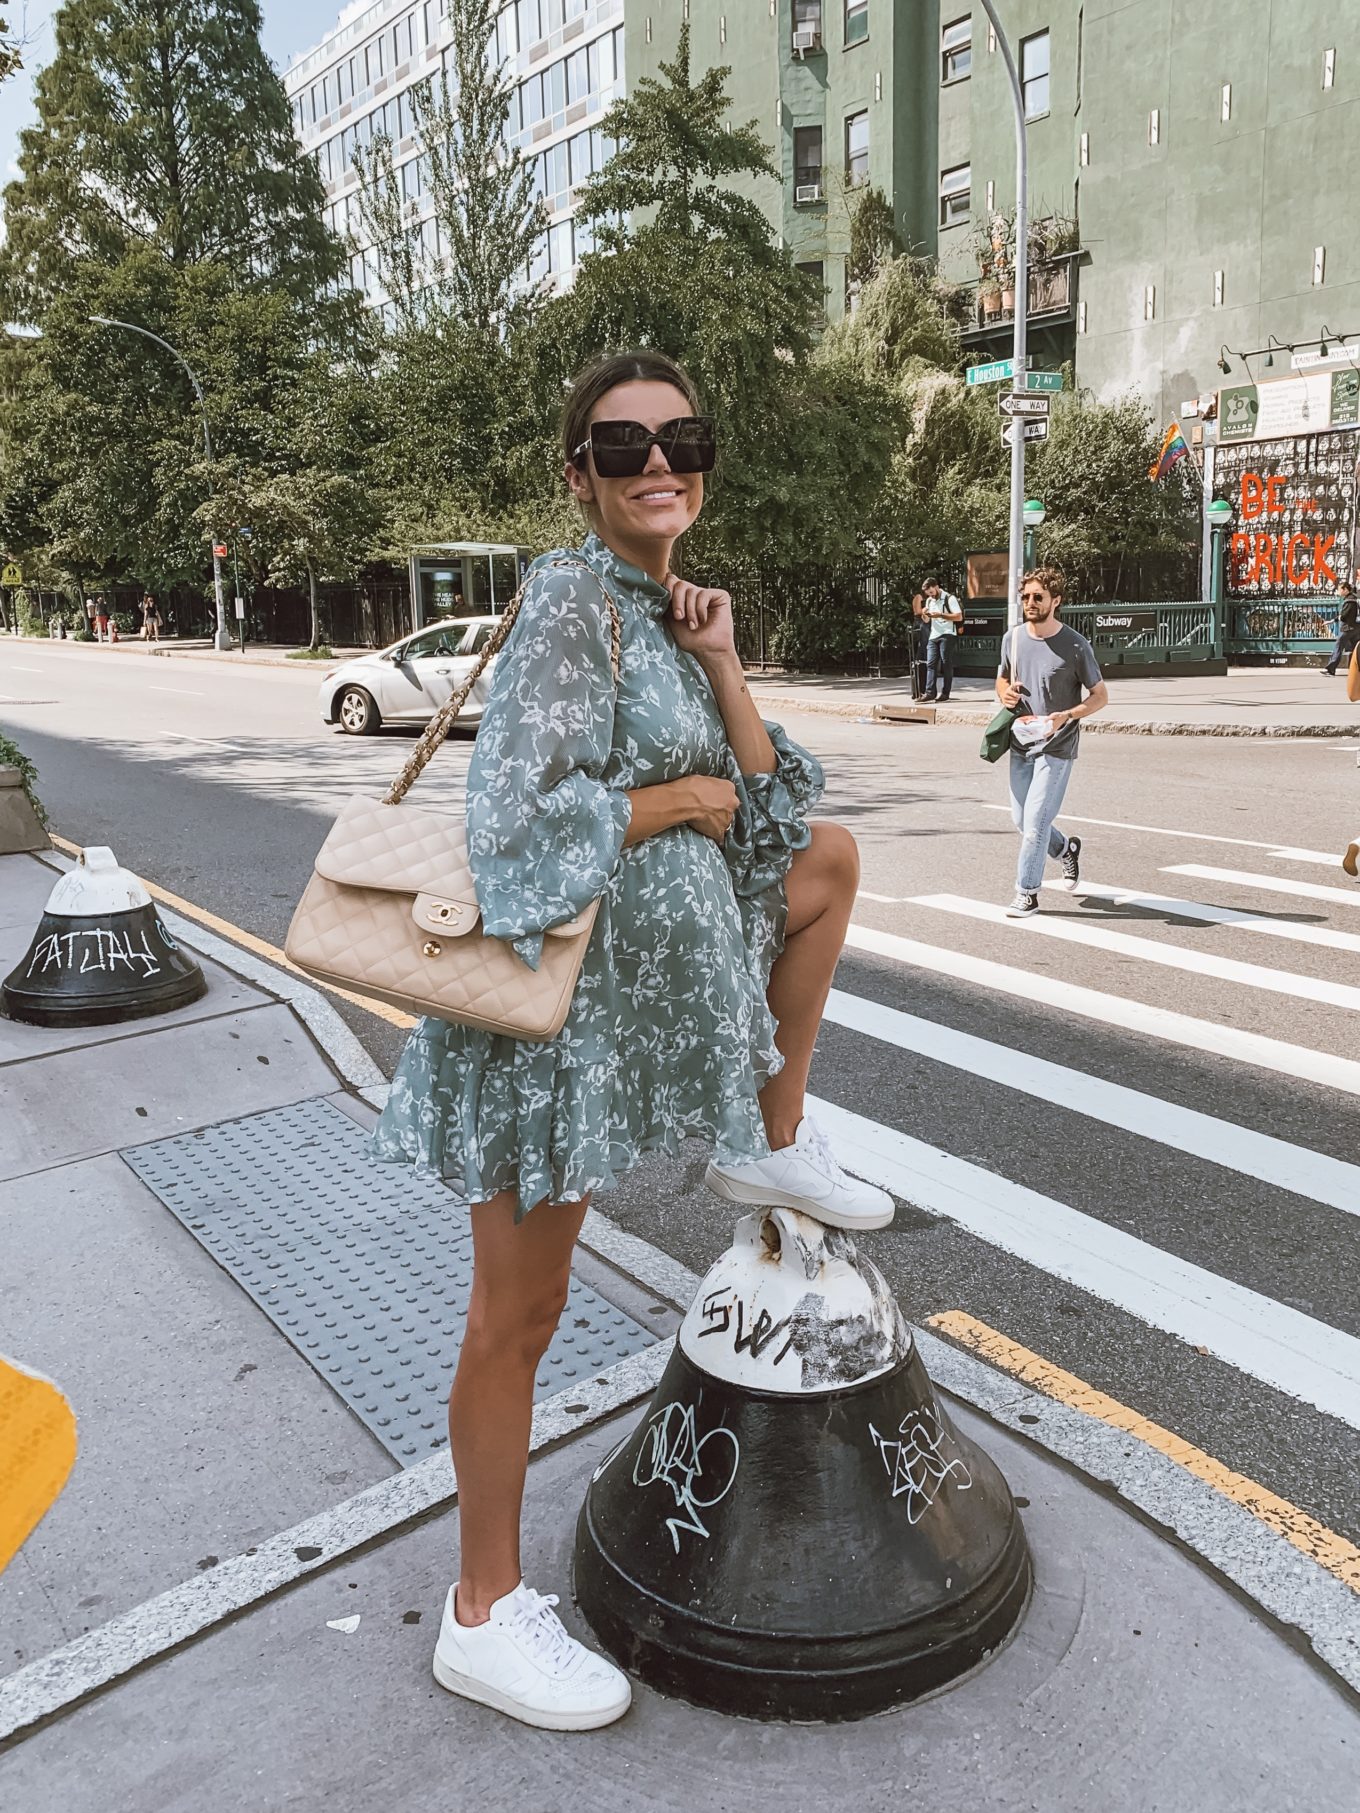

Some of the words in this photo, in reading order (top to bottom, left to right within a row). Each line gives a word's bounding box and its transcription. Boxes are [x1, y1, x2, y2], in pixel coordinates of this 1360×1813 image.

[967, 369, 972, 384] E
[974, 365, 1005, 381] Houston
[1035, 375, 1040, 388] 2
[1043, 375, 1053, 385] Av
[1005, 400, 1021, 409] ONE
[1029, 401, 1046, 410] WAY
[1222, 422, 1253, 432] AVALON
[1240, 472, 1287, 520] BE
[1231, 532, 1338, 588] BRICK
[1095, 615, 1133, 629] Subway
